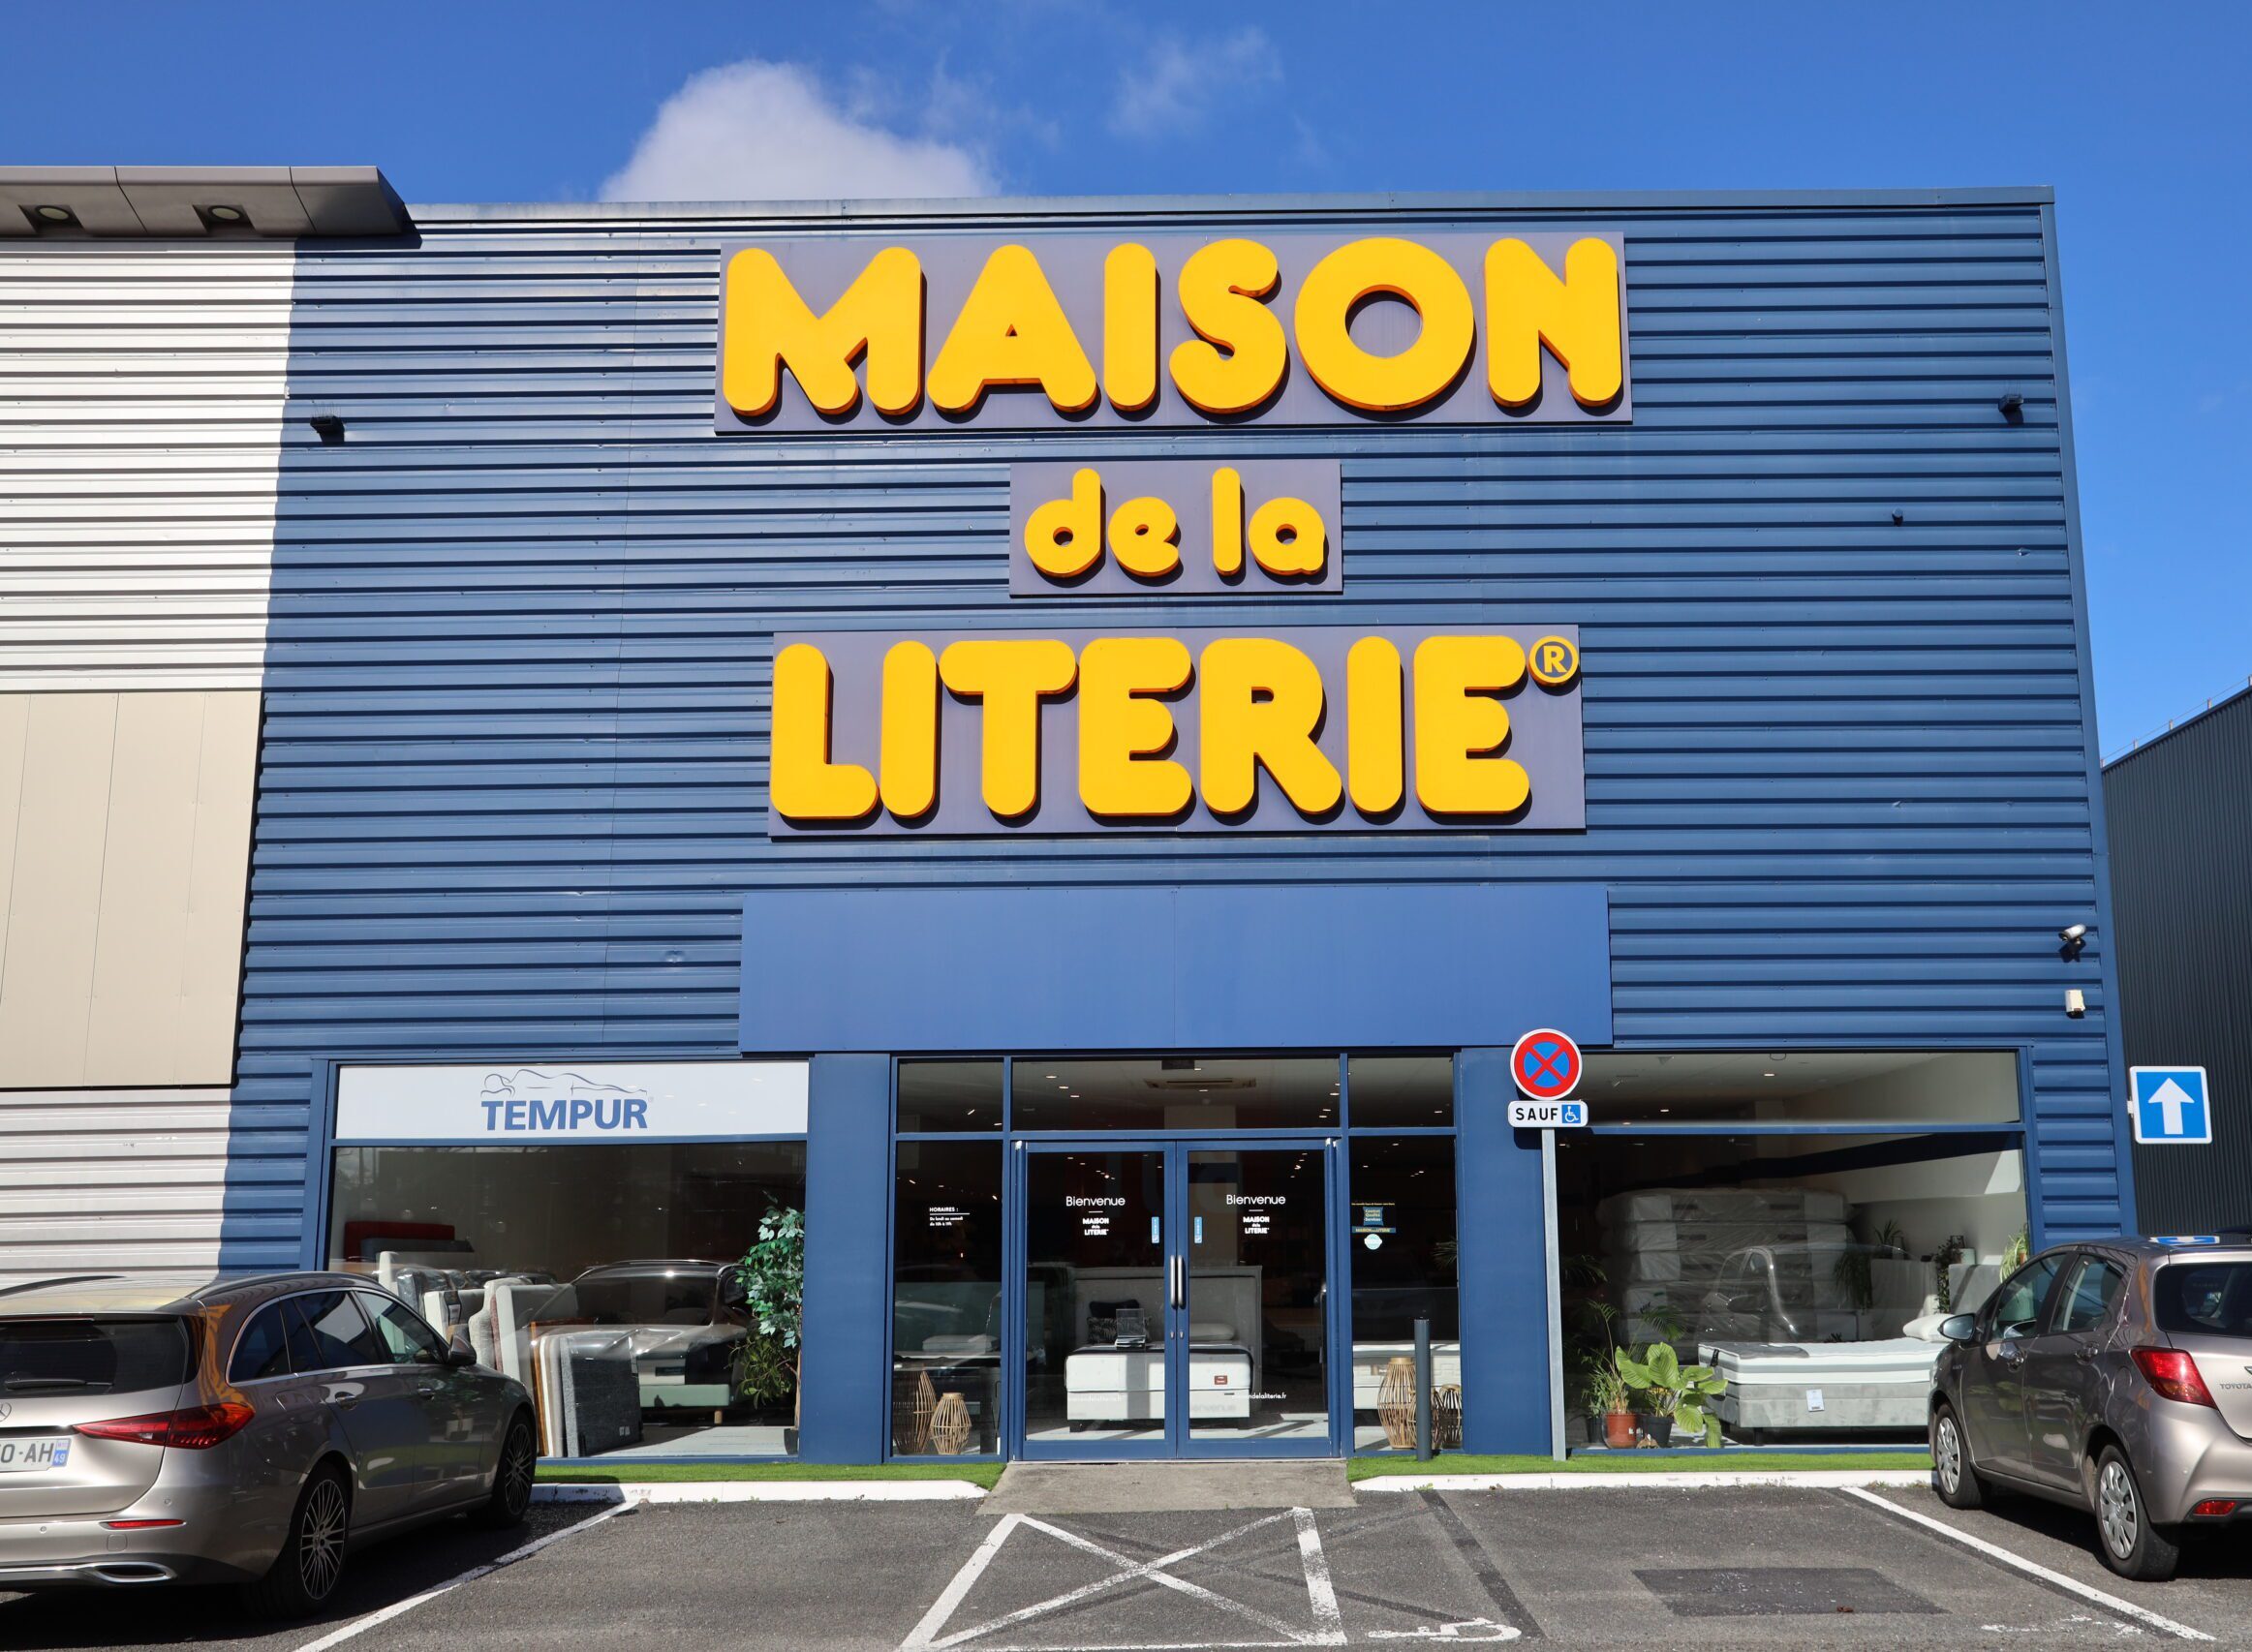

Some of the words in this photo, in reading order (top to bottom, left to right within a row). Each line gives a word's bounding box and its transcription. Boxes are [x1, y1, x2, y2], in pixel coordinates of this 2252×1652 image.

[722, 236, 1623, 416] MAISON
[1024, 468, 1181, 578] de
[1212, 467, 1327, 578] la
[481, 1099, 648, 1131] TEMPUR
[1515, 1107, 1558, 1121] SAUF
[1065, 1195, 1126, 1207] Bienvenue
[1226, 1194, 1286, 1205] Bienvenue
[54, 1453, 66, 1464] 49
